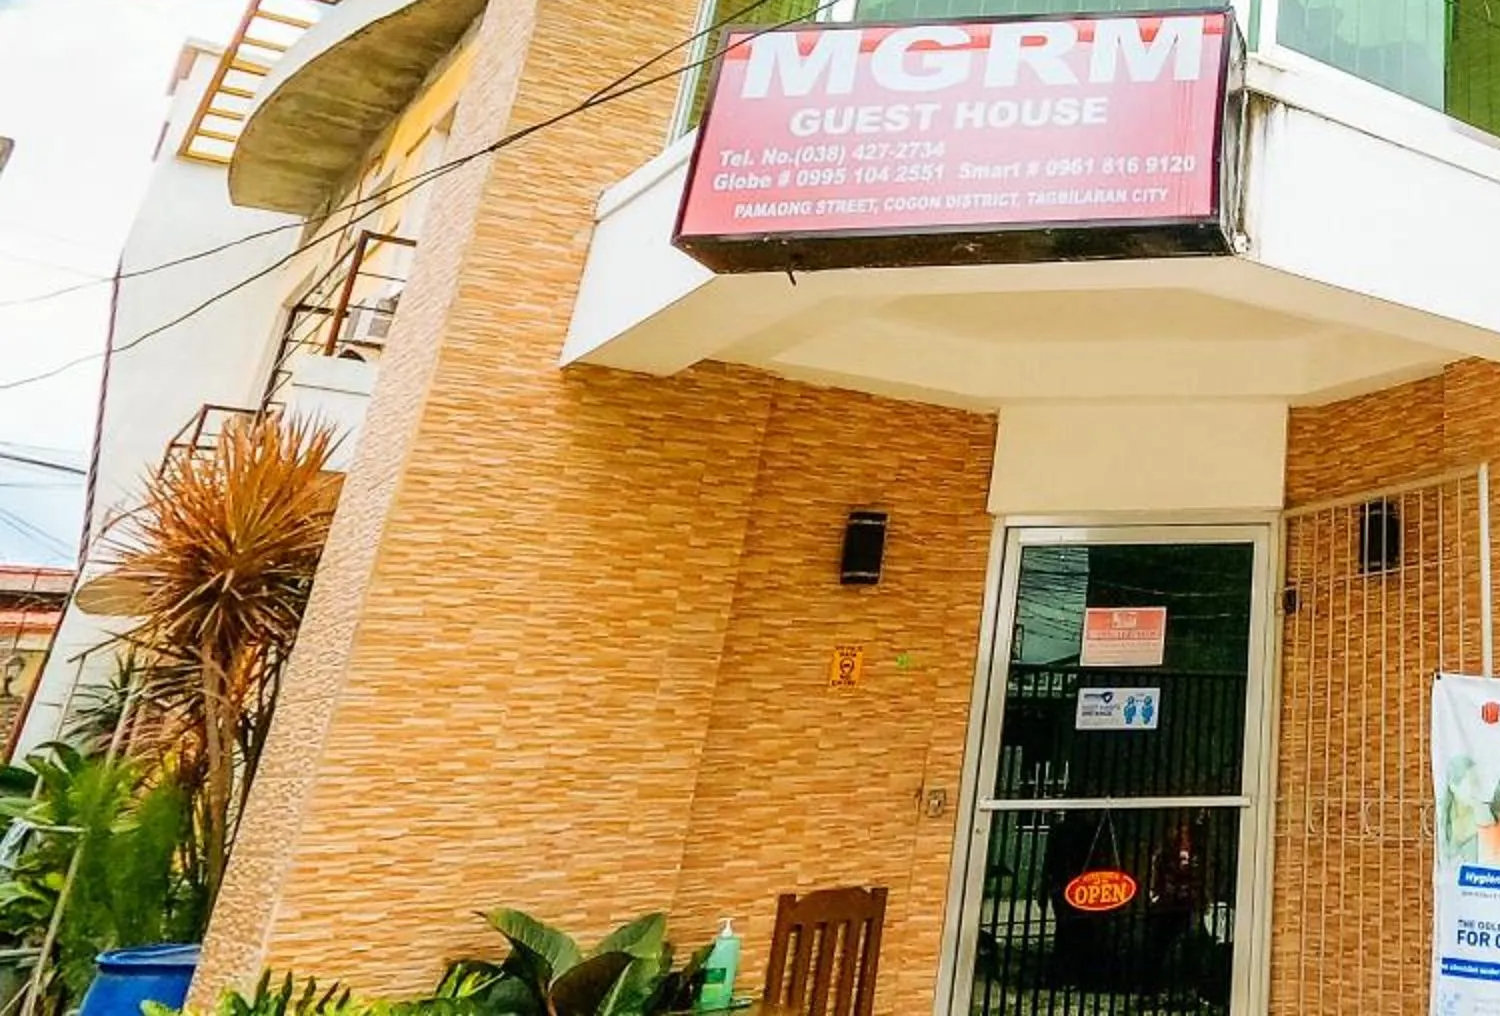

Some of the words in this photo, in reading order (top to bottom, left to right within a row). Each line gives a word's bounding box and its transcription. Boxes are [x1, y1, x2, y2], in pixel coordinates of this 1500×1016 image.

[744, 18, 1202, 98] MGRM
[791, 104, 940, 136] GUEST
[957, 99, 1107, 128] HOUSE
[719, 149, 753, 167] Tel.
[713, 173, 771, 191] Globe
[777, 170, 790, 187] #
[796, 167, 846, 187] 0995
[959, 161, 1020, 180] Smart
[734, 201, 812, 219] PAMAONG
[883, 195, 942, 212] COGON
[1132, 187, 1169, 203] CITY
[1075, 882, 1127, 904] OPEN
[1457, 929, 1491, 947] FOR
